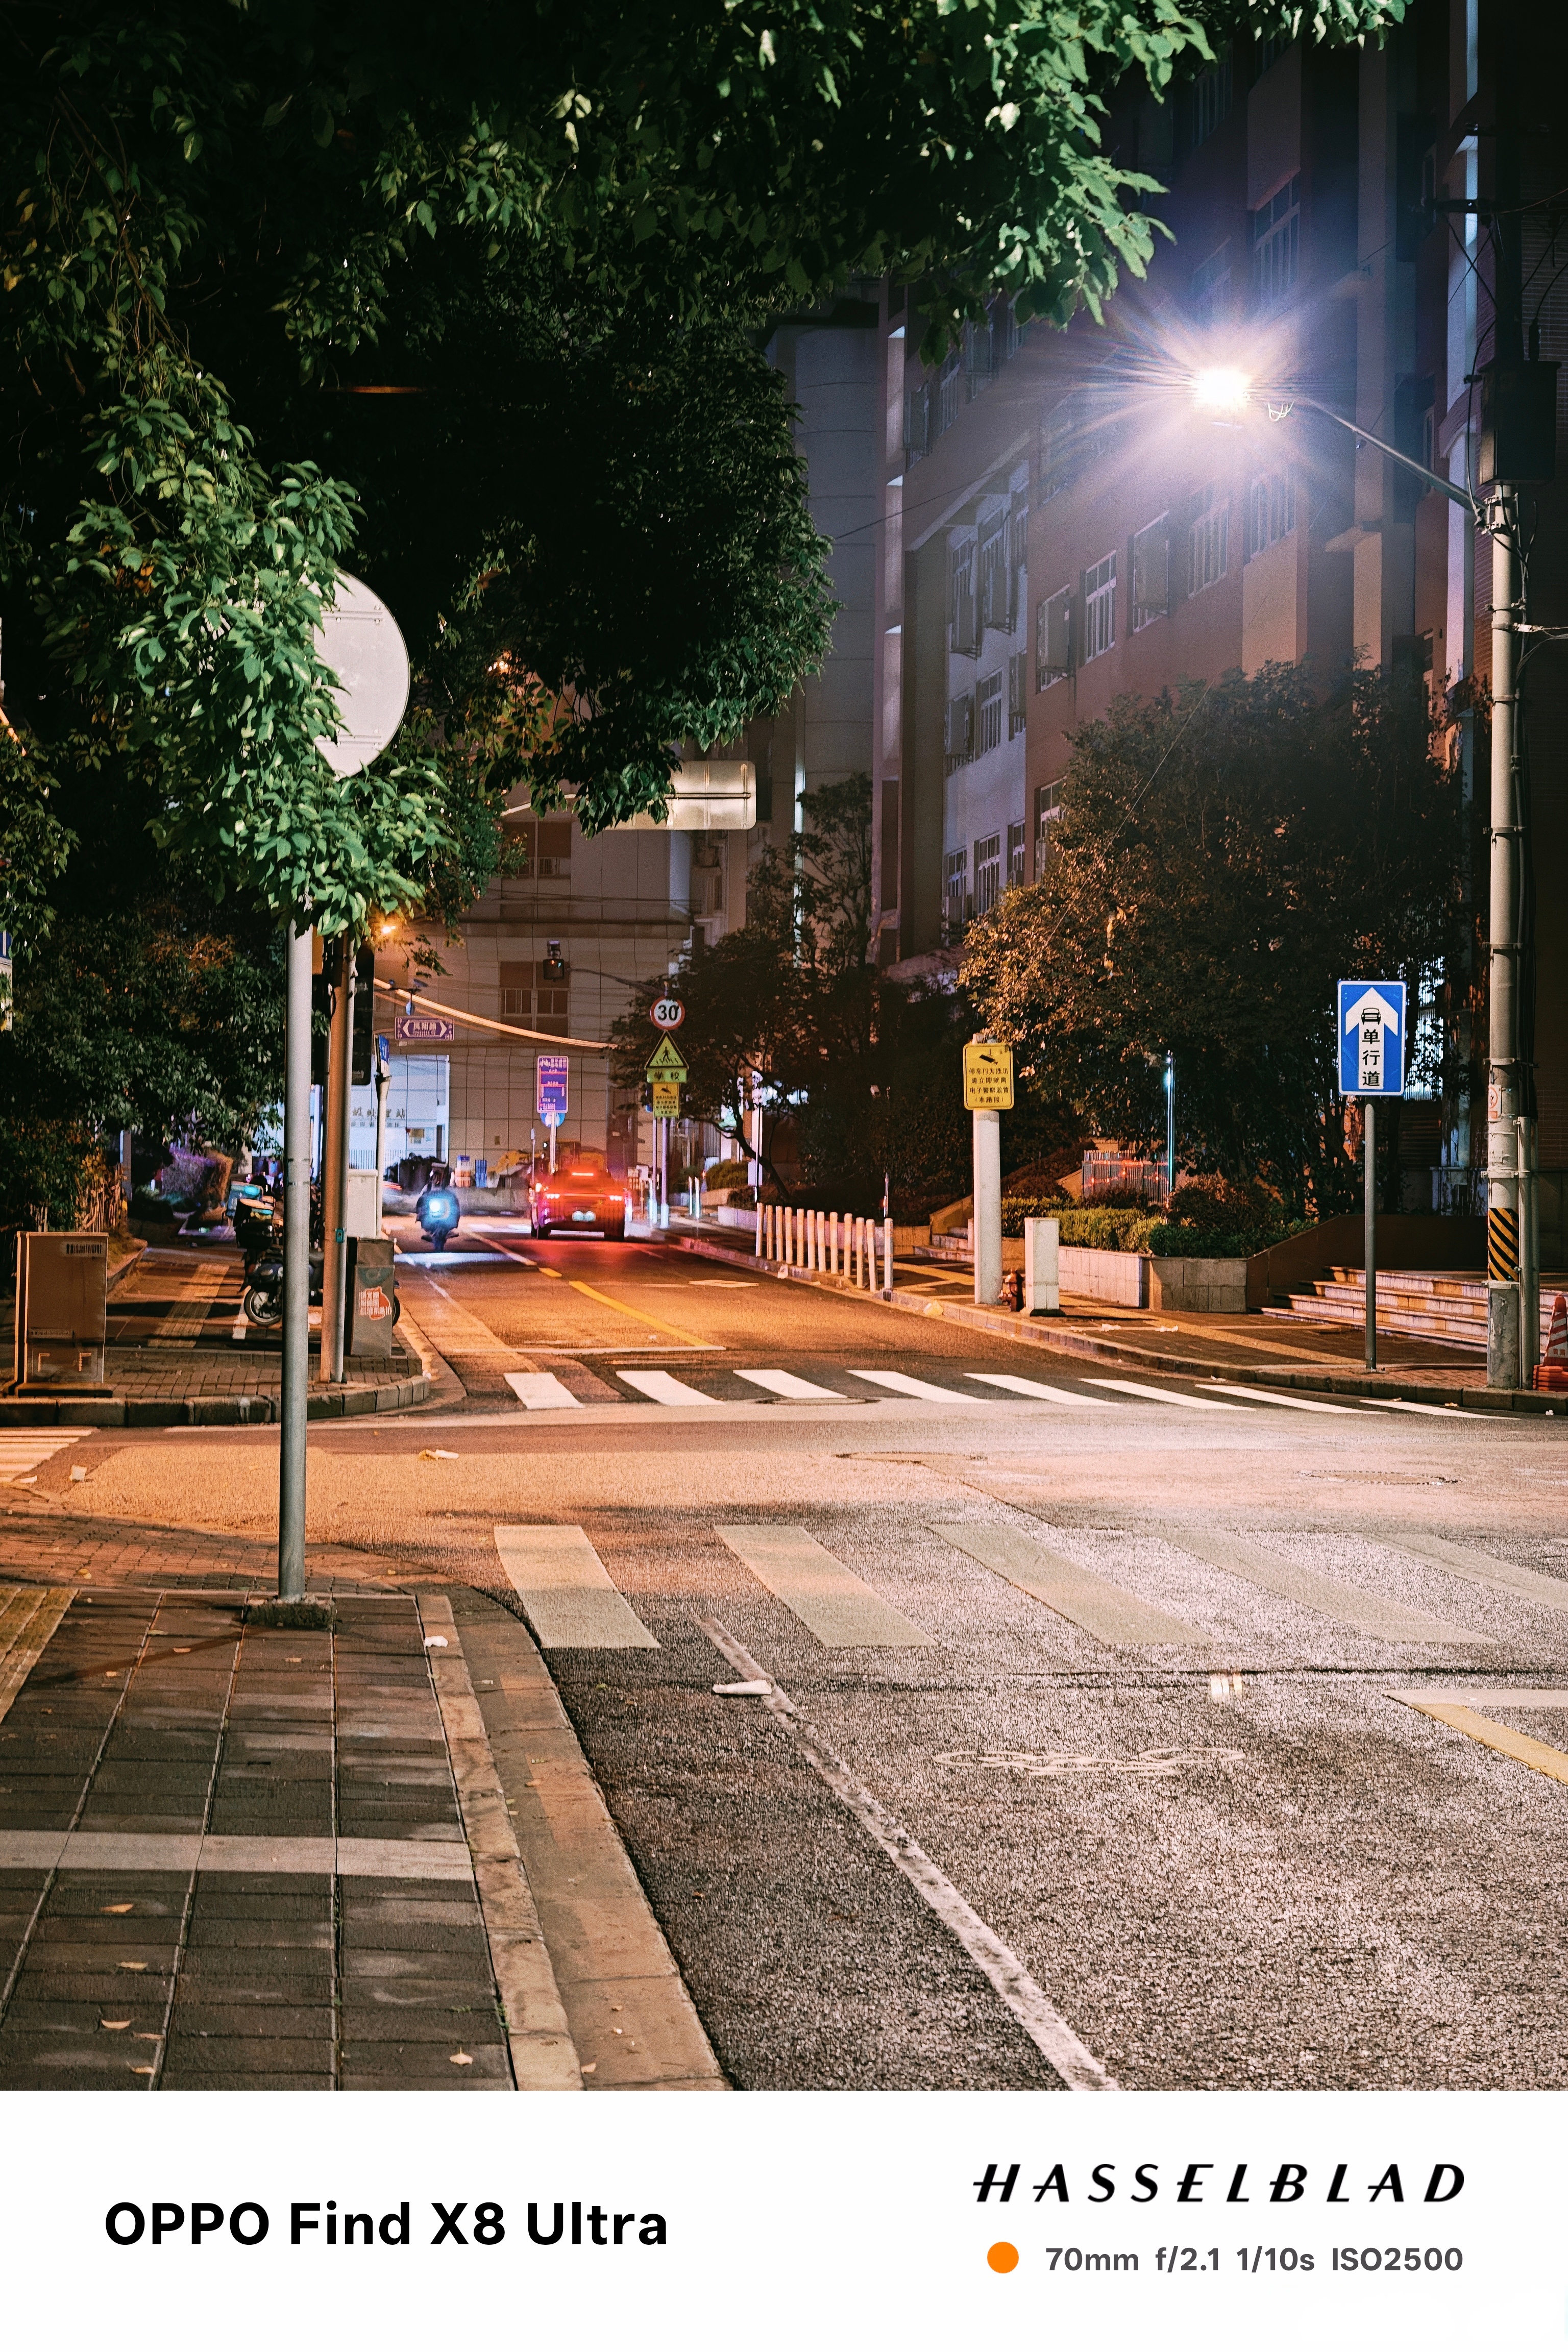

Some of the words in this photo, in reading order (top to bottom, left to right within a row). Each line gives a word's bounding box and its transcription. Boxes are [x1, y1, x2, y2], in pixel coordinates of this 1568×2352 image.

[658, 1004, 679, 1021] 30
[1362, 1028, 1381, 1087] 单行道
